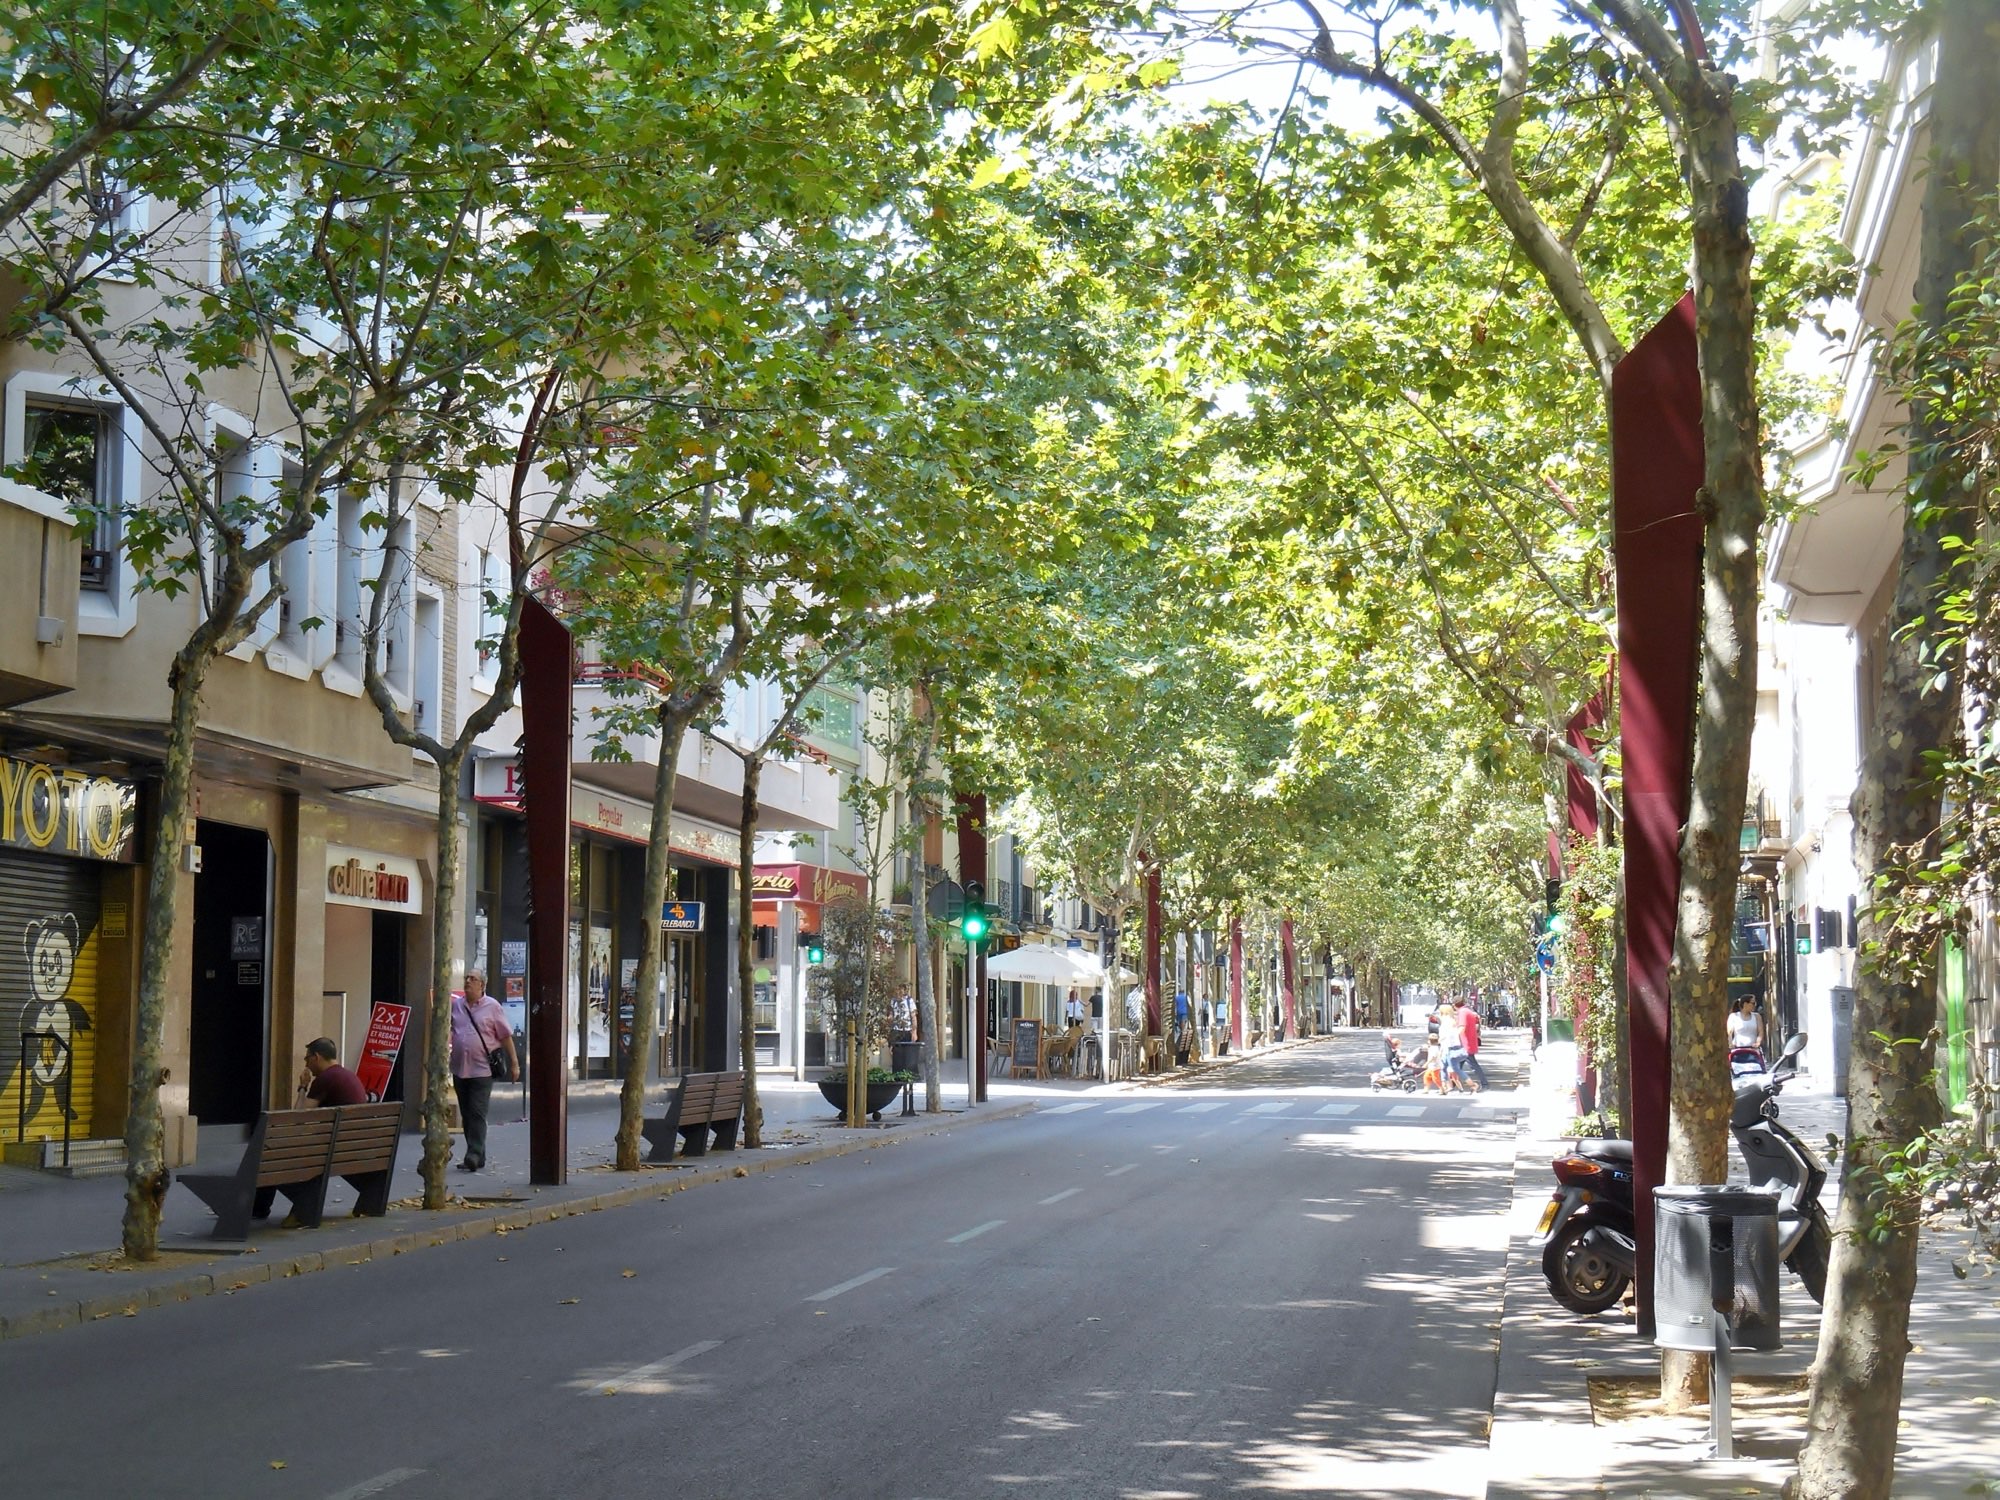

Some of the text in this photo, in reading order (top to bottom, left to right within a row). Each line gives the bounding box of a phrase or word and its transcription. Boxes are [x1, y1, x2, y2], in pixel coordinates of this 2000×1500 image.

[598, 802, 623, 828] Popular
[328, 858, 409, 903] culinarium
[752, 871, 796, 889] eria
[377, 1031, 400, 1041] REGALA
